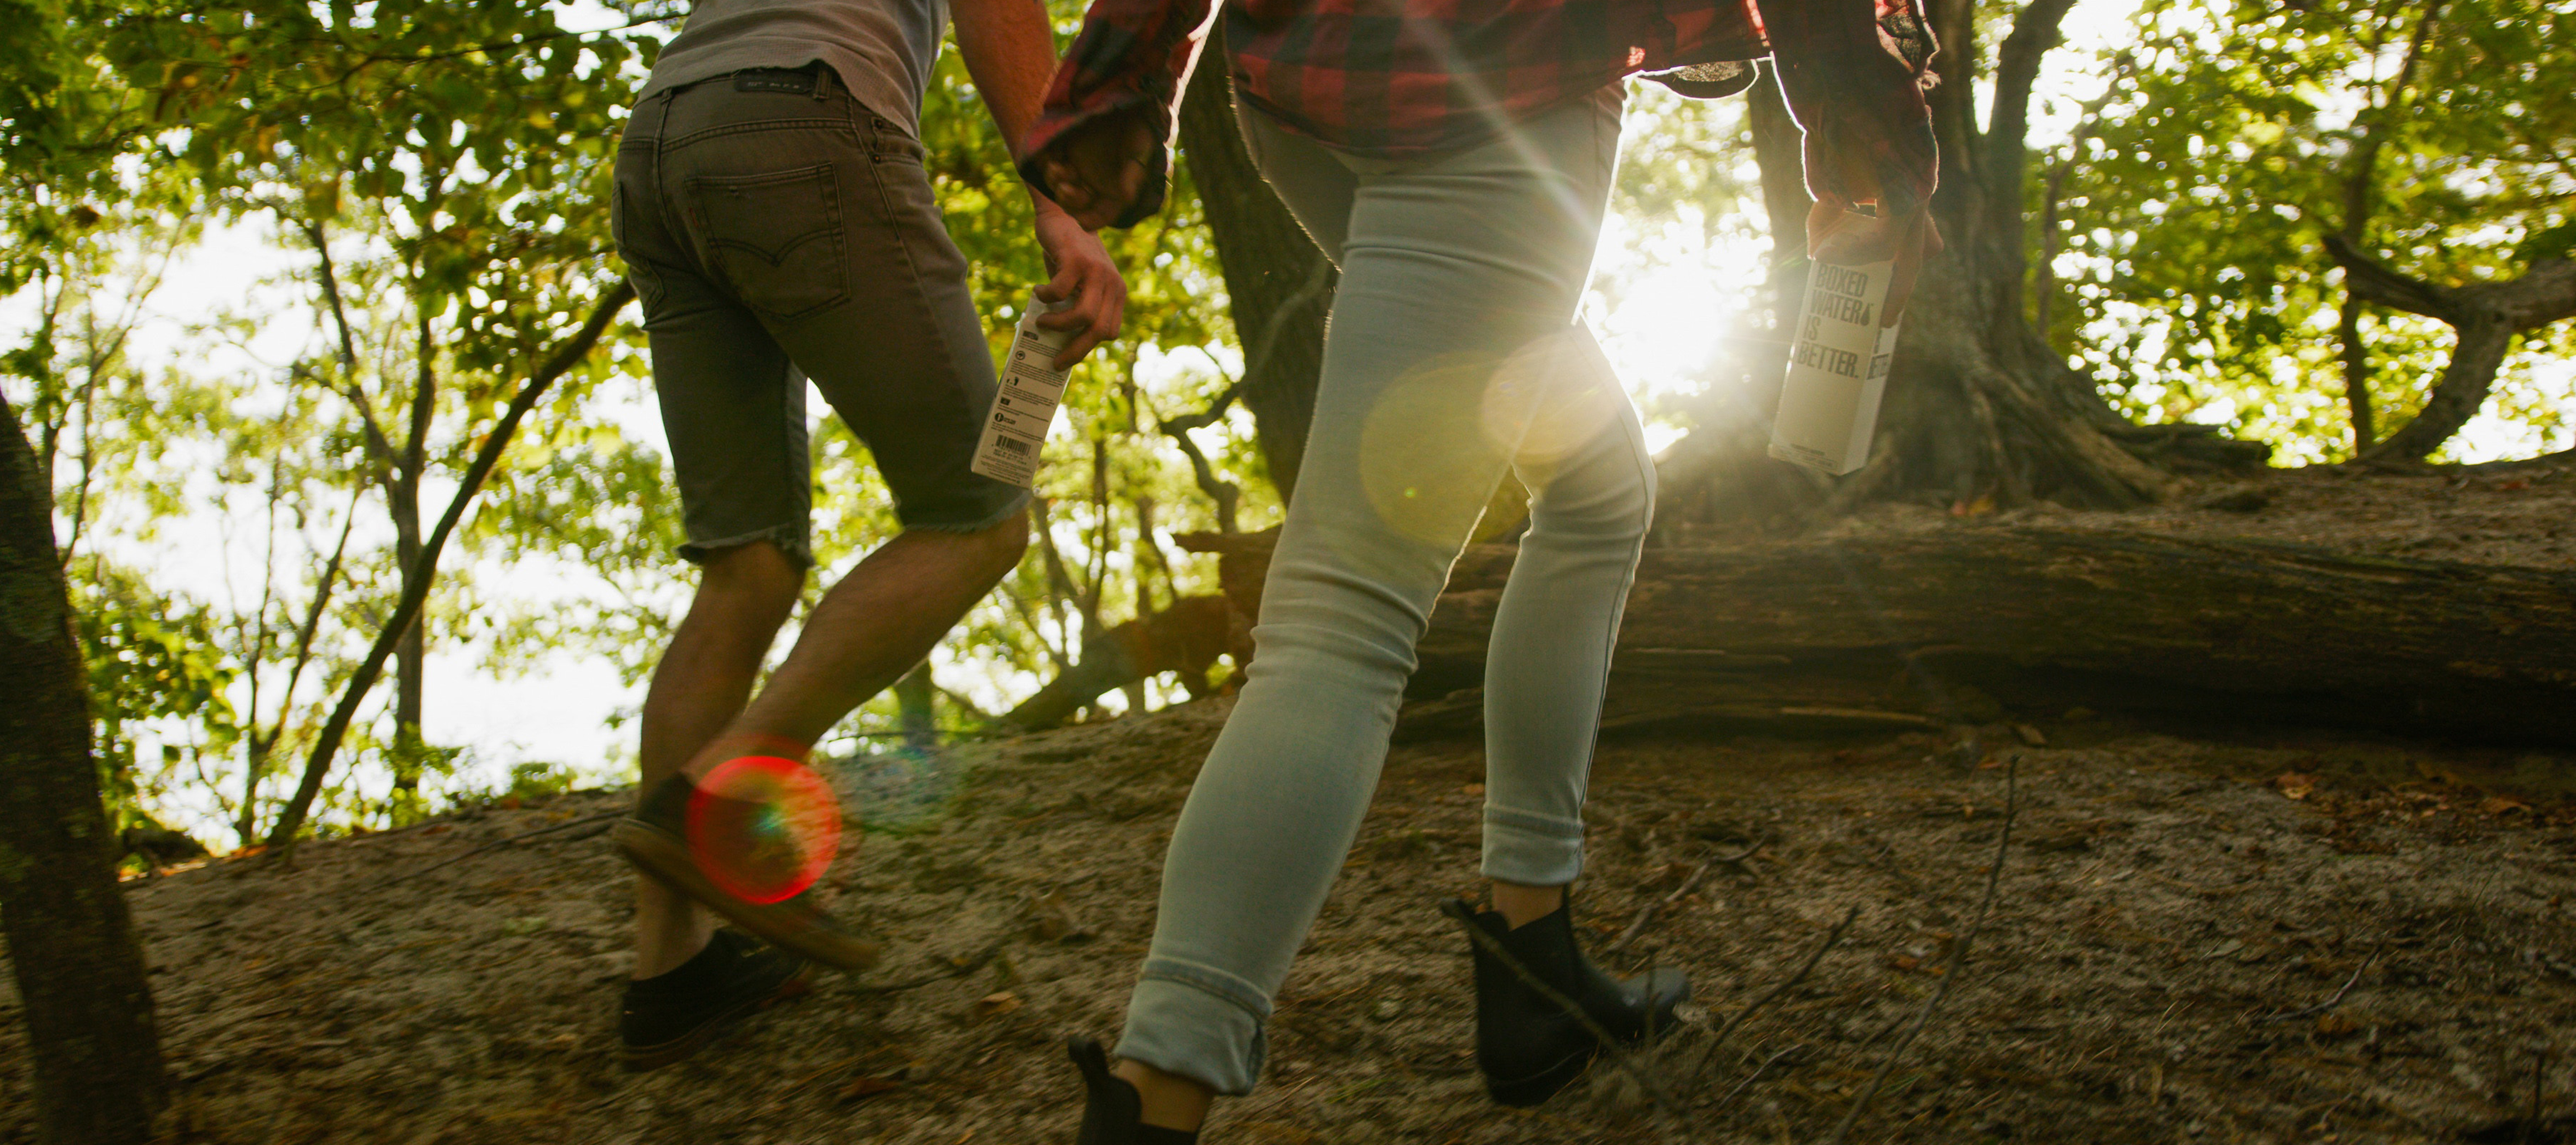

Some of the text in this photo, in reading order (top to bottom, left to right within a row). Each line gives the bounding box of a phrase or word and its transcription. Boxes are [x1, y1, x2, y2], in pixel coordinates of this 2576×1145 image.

[1815, 264, 1868, 298] BOXED
[1810, 290, 1863, 325] WATER
[1802, 315, 1820, 341] IS
[1798, 342, 1859, 379] BETTER.
